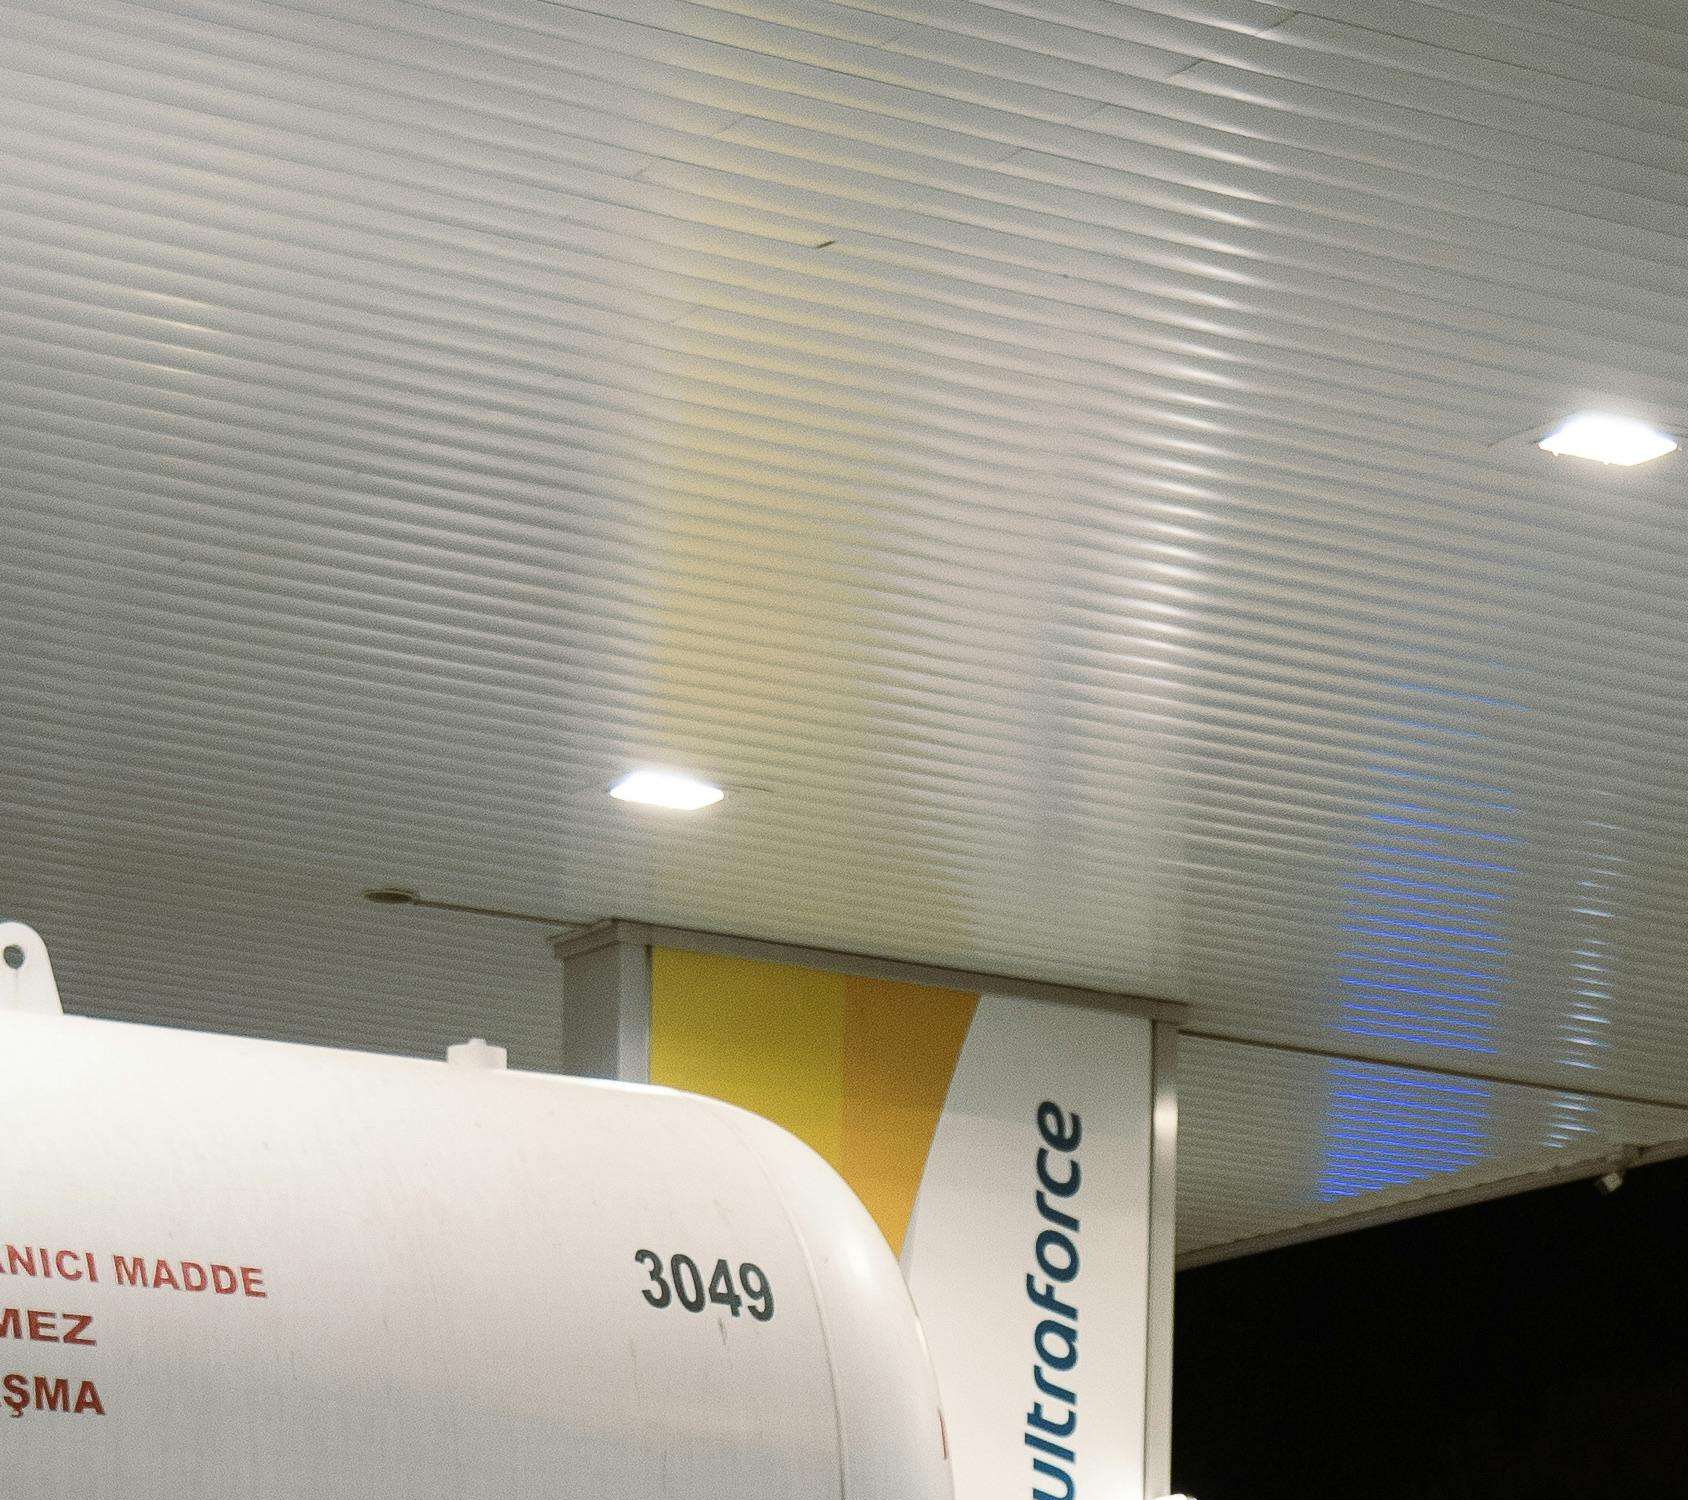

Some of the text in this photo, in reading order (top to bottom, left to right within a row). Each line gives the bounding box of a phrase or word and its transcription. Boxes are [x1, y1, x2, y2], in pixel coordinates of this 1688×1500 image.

[0, 1244, 268, 1298] NICI MADDE
[635, 1248, 775, 1323] 3049
[3, 1373, 105, 1418] ŞMA
